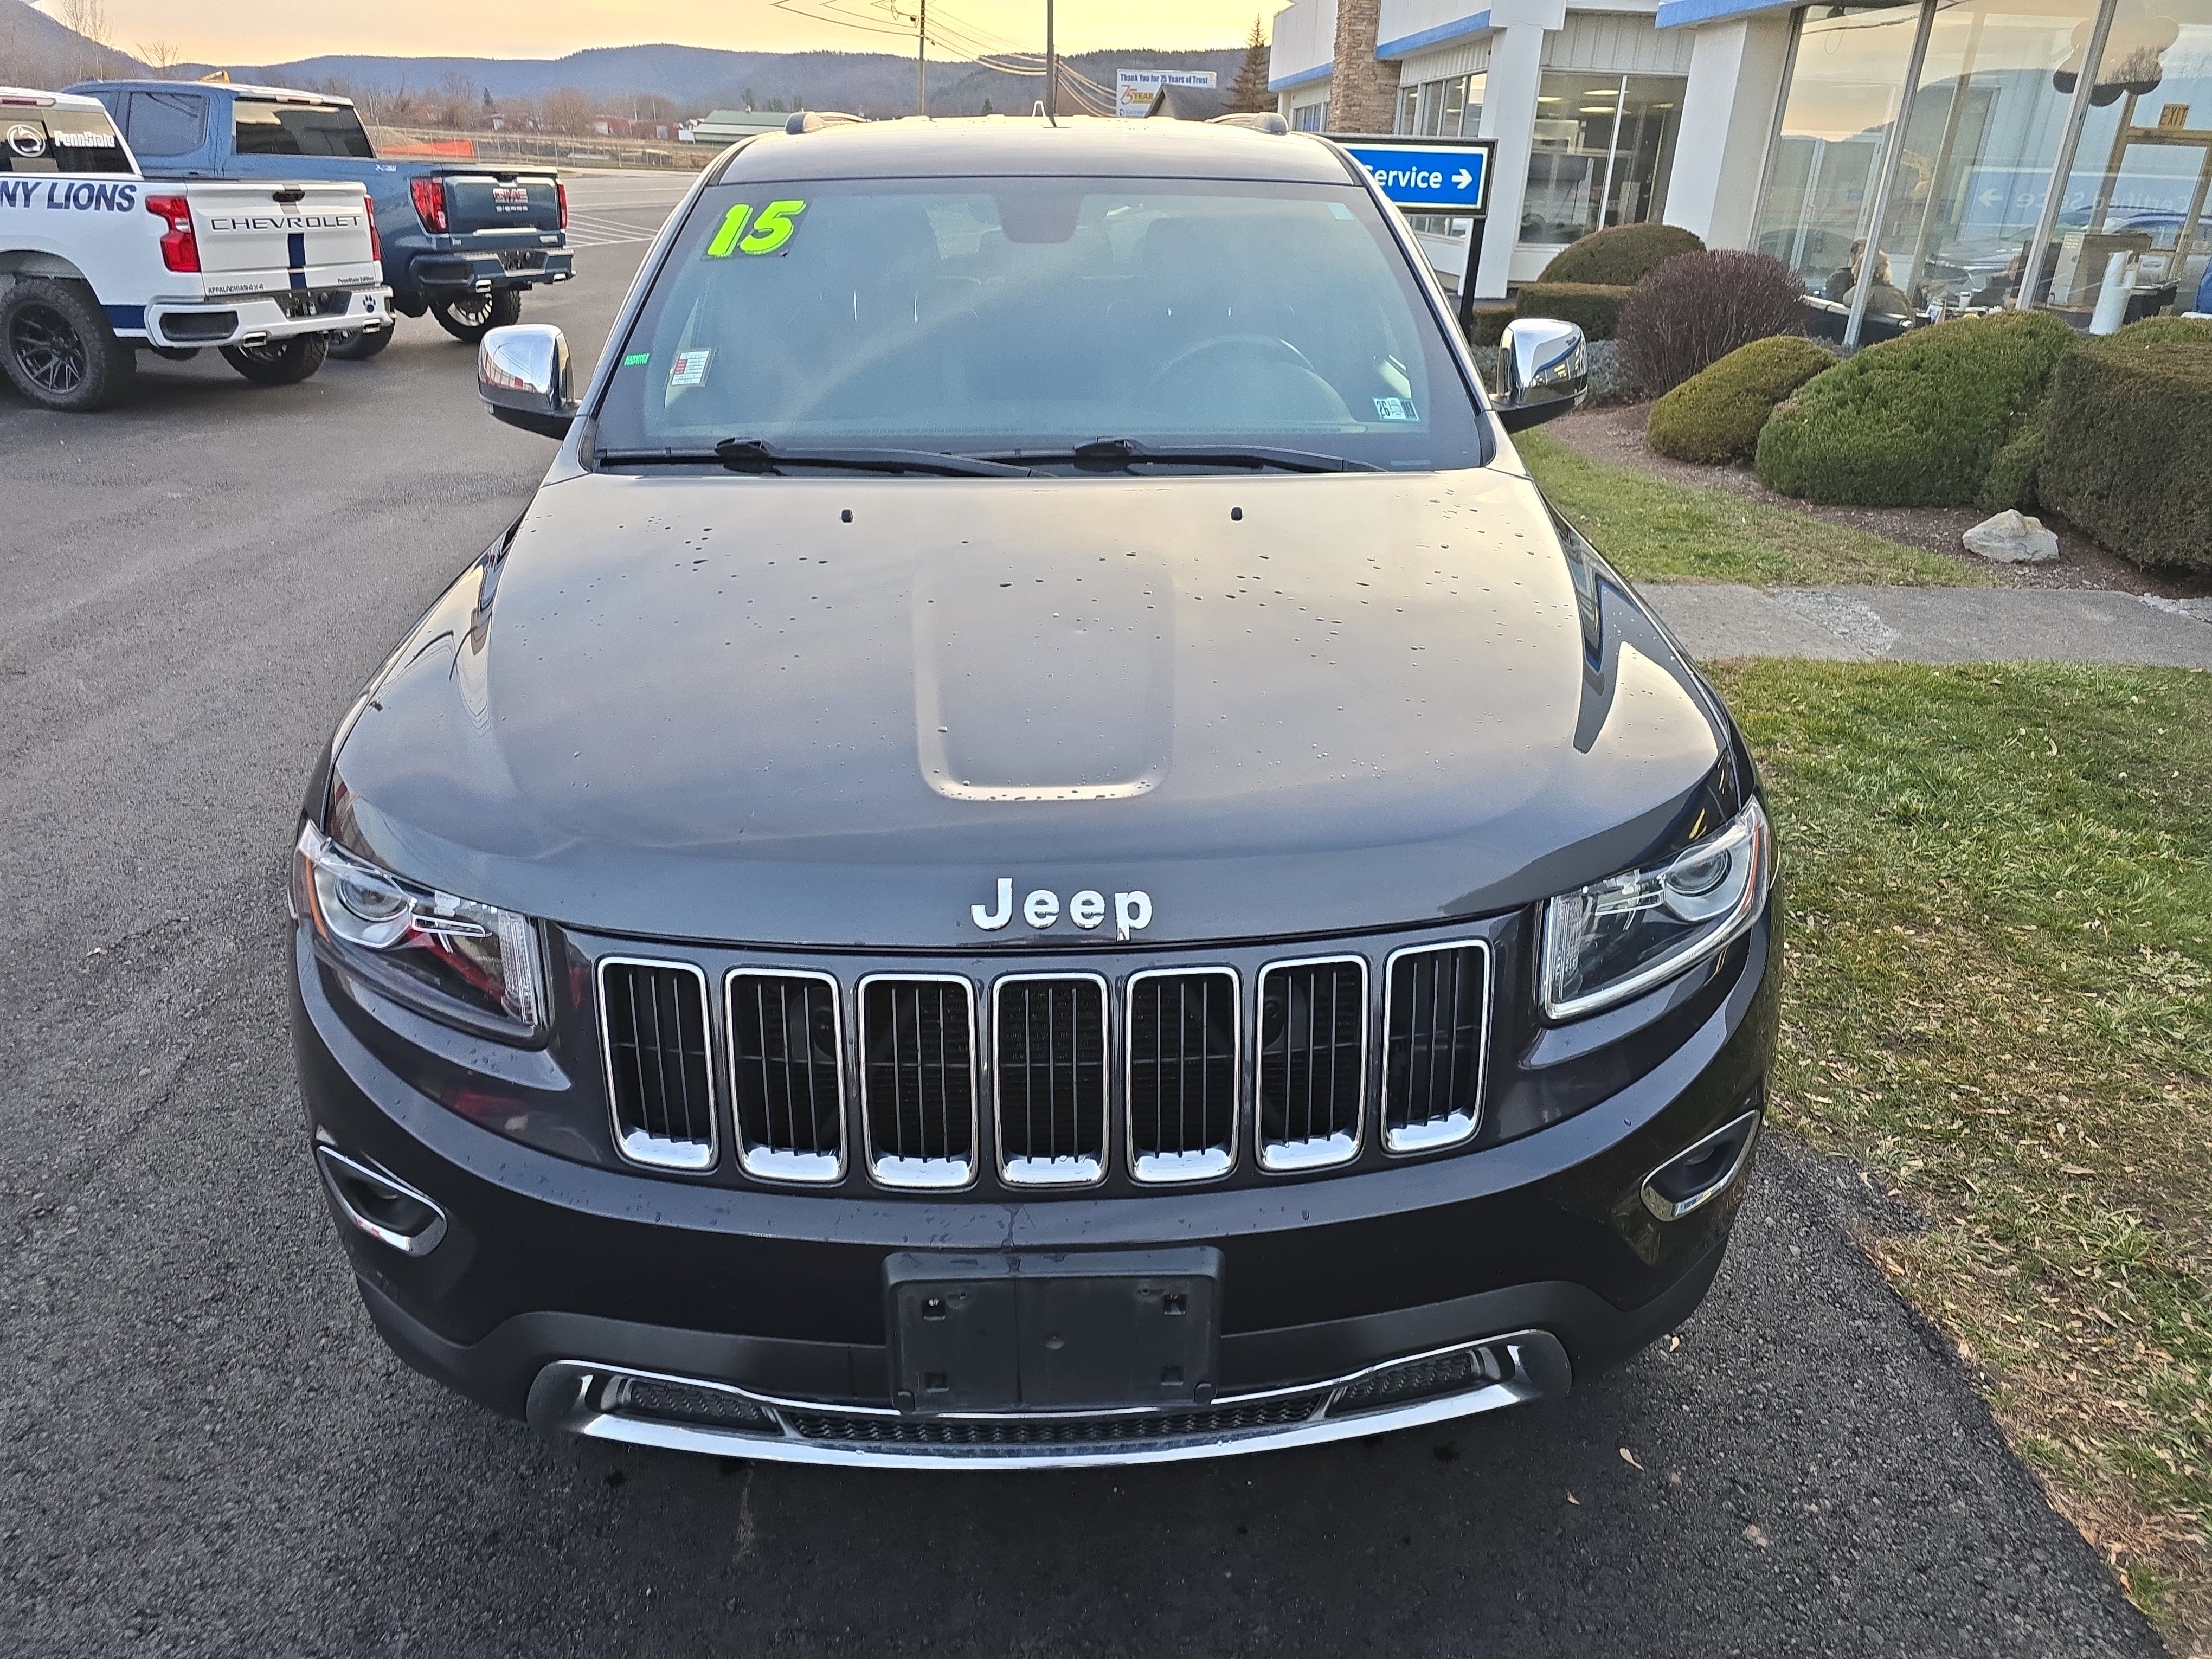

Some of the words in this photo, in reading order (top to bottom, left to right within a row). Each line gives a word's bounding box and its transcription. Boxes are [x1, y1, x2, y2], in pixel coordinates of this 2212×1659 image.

[1120, 74, 1138, 82] Thank
[1140, 74, 1149, 82] You
[1160, 75, 1167, 83] 75
[1168, 75, 1184, 83] Years
[1193, 76, 1208, 85] Trust
[1120, 85, 1137, 105] 75
[2159, 106, 2189, 126] EXIT
[53, 130, 115, 148] PennState
[47, 182, 137, 213] LIONS
[211, 216, 362, 231] CHEVROLET
[707, 200, 806, 258] 15
[1376, 400, 1390, 416] 26
[970, 877, 1153, 943] Jeep
